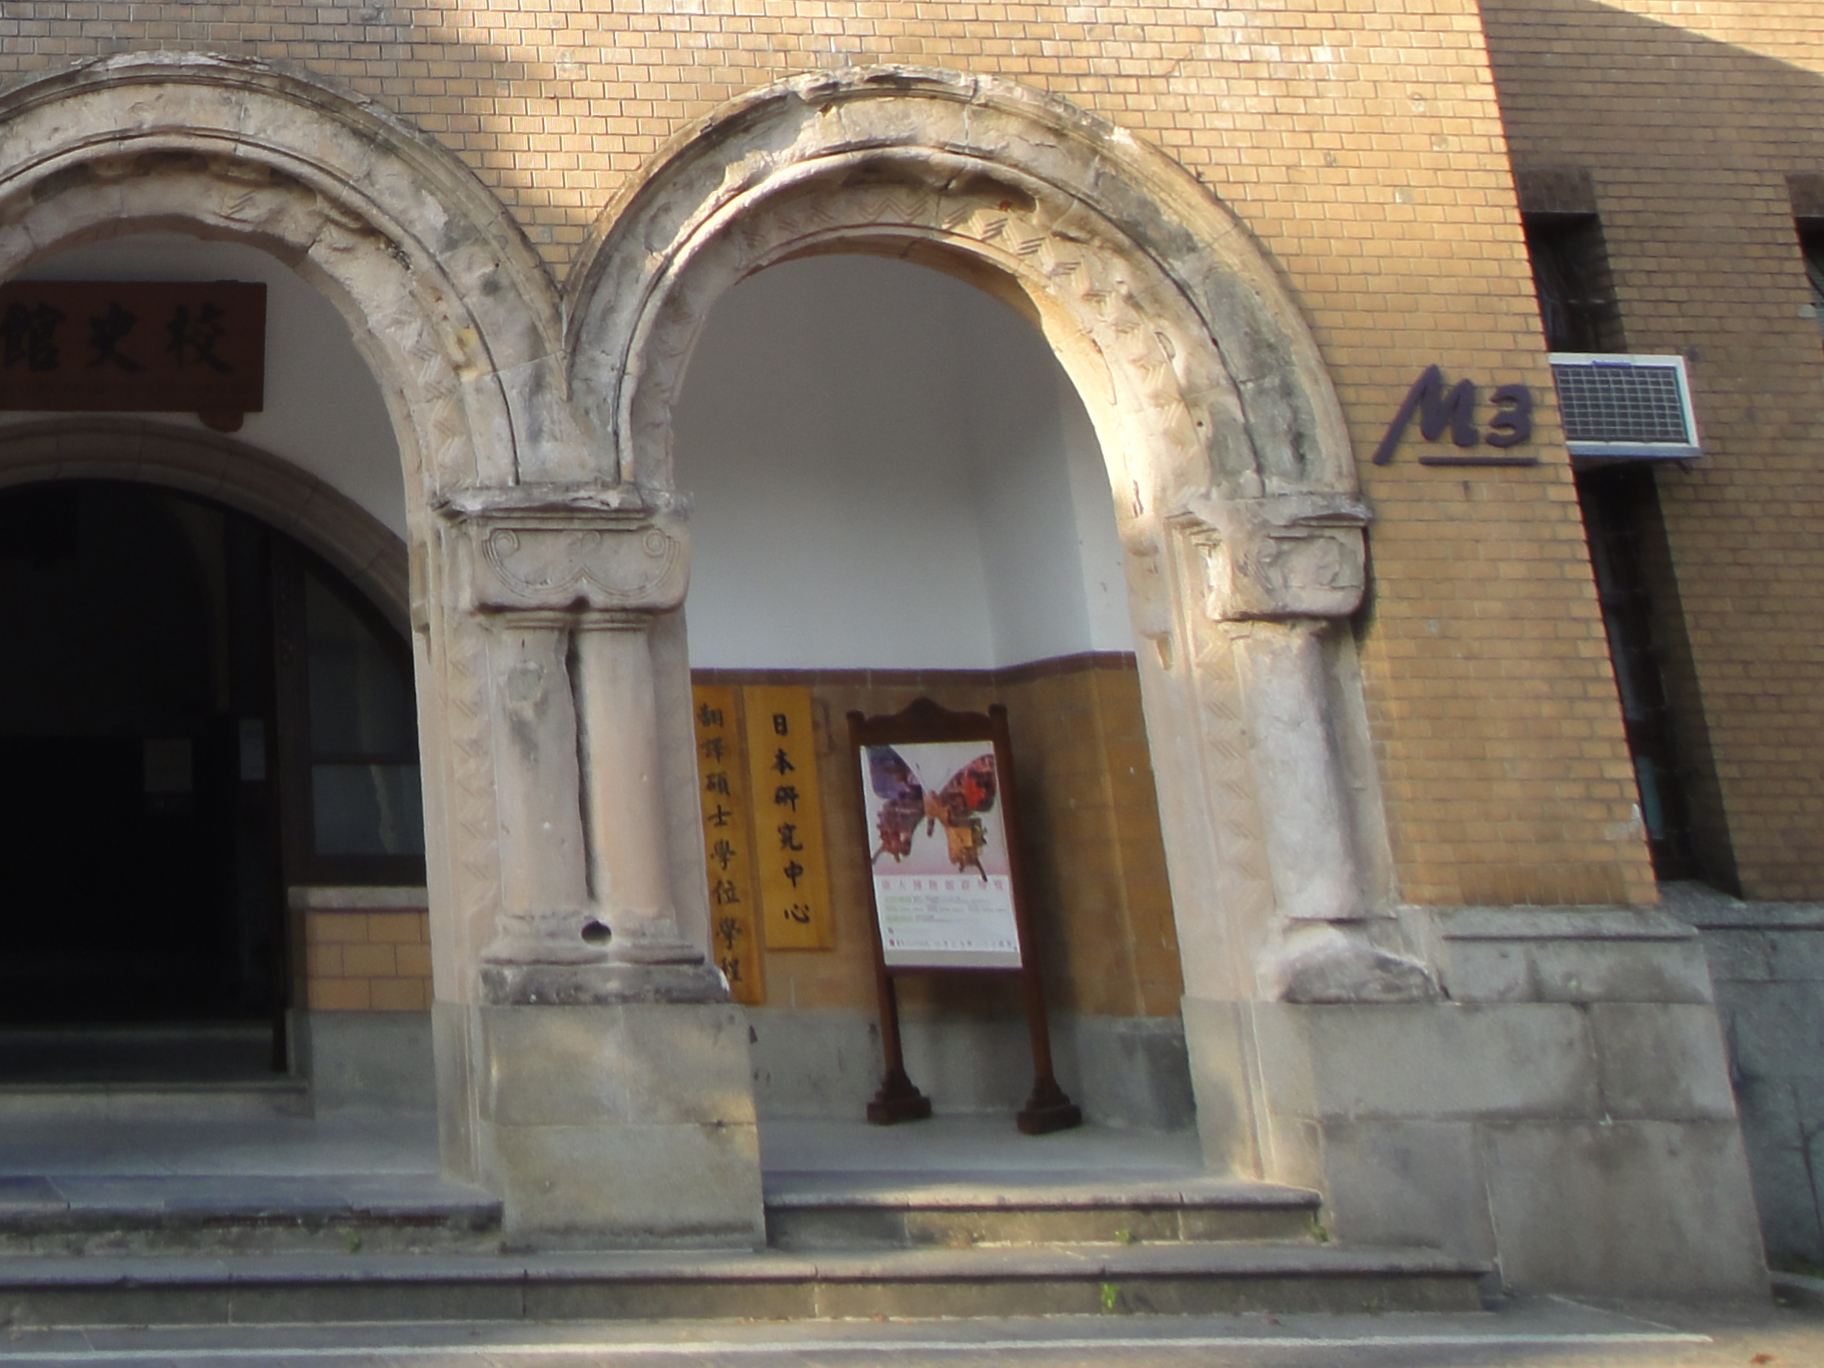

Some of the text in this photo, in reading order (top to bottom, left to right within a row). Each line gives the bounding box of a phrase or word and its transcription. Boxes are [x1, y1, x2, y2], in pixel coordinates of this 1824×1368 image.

[1372, 364, 1533, 466] M3
[772, 713, 811, 925] 日本研究中心
